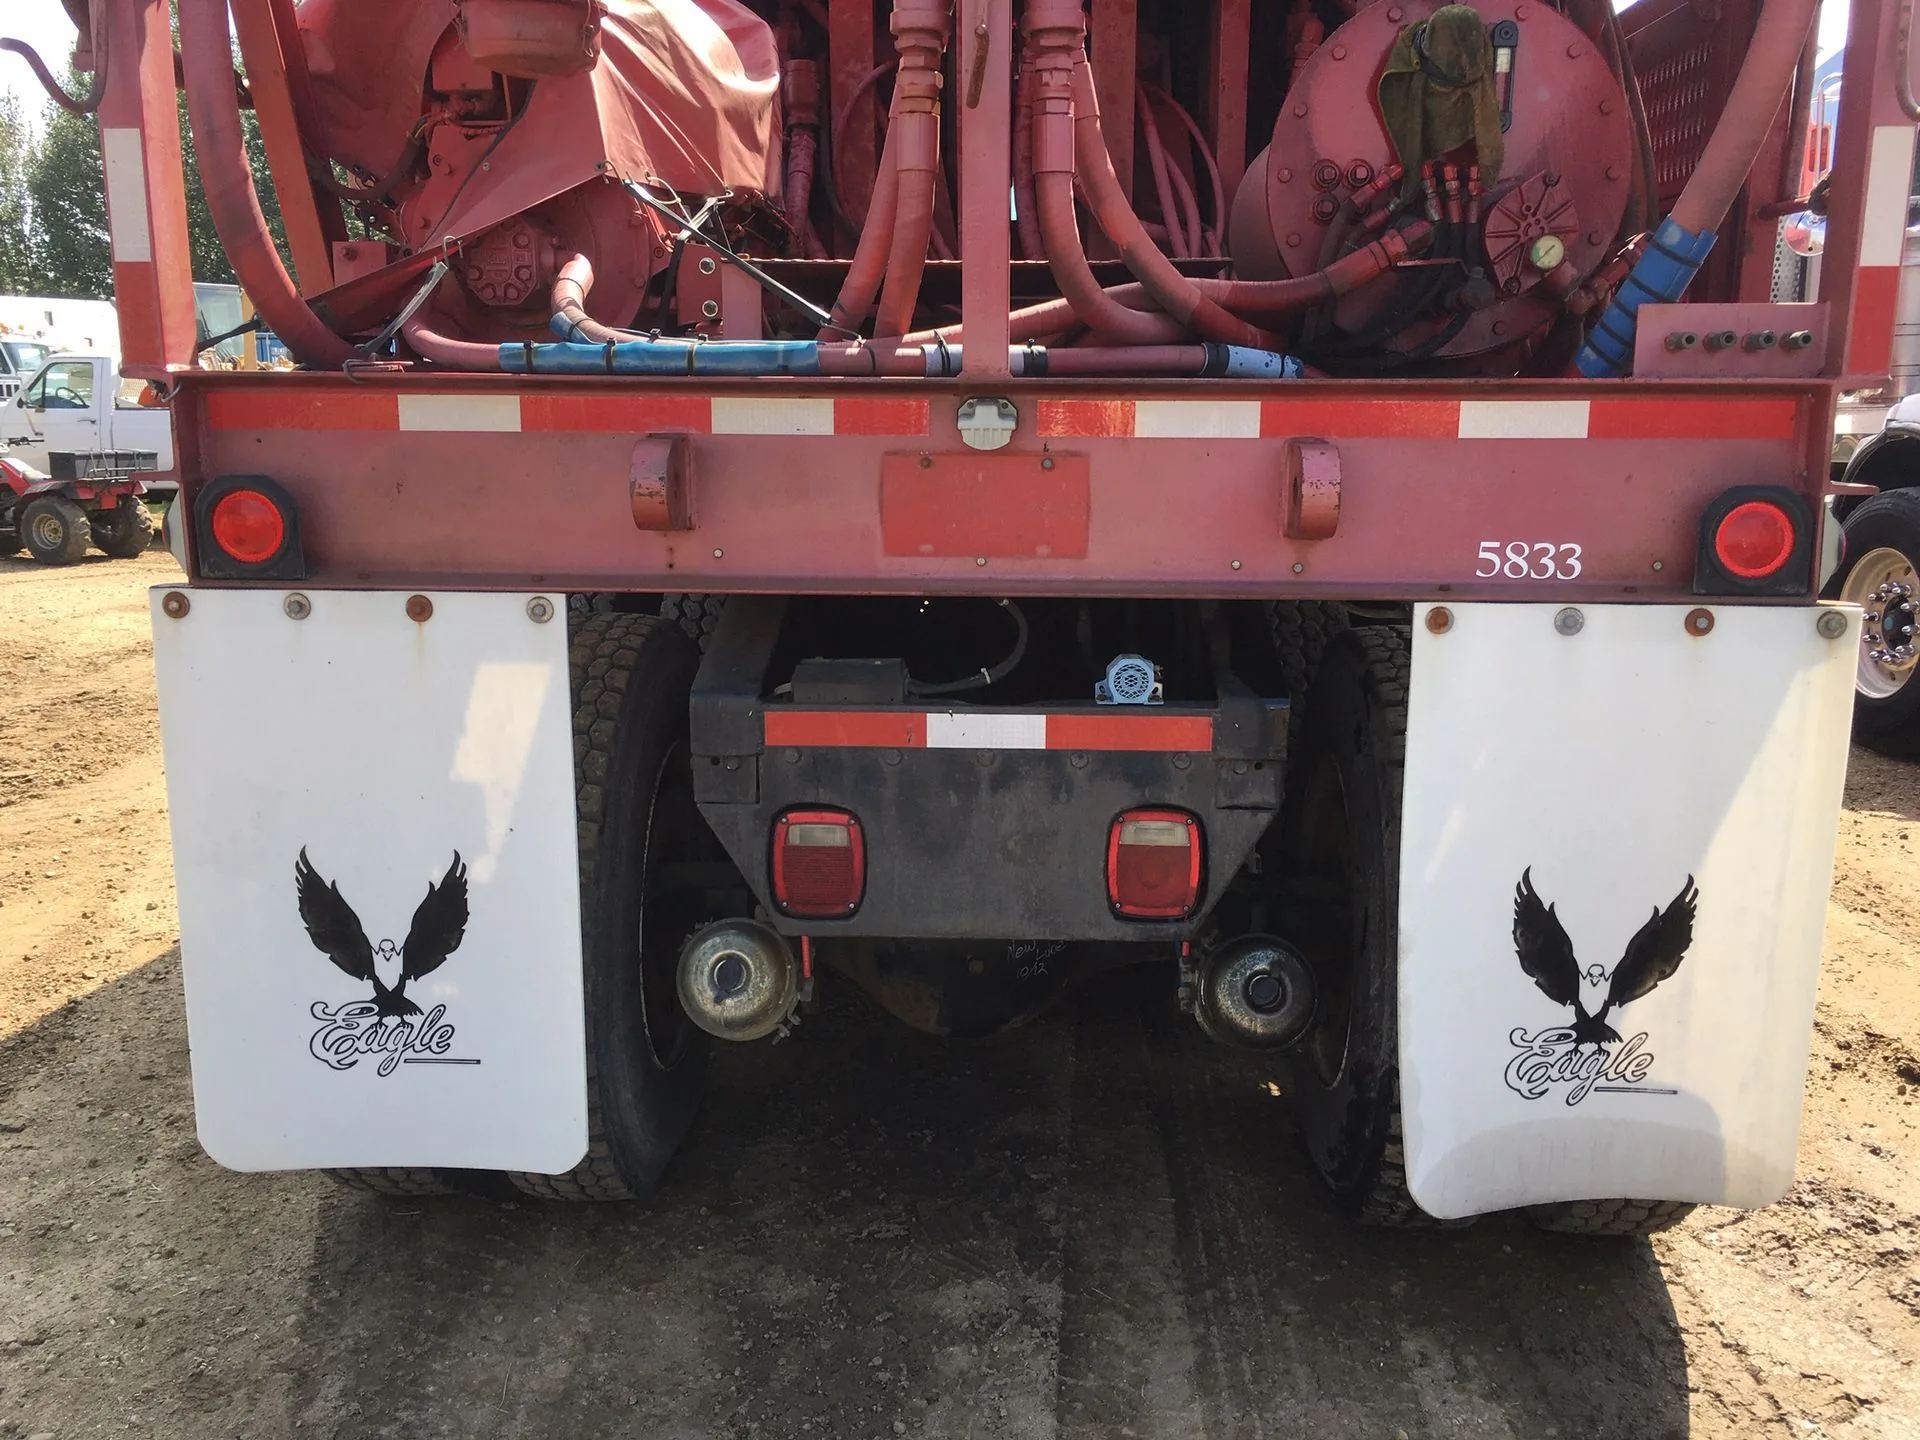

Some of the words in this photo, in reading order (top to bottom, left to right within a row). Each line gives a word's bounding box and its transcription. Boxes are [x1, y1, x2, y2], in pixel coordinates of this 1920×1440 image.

[1474, 540, 1583, 580] 5833
[1007, 937, 1036, 962] New
[309, 1000, 456, 1078] Eagle
[1504, 1026, 1655, 1107] Eagle
